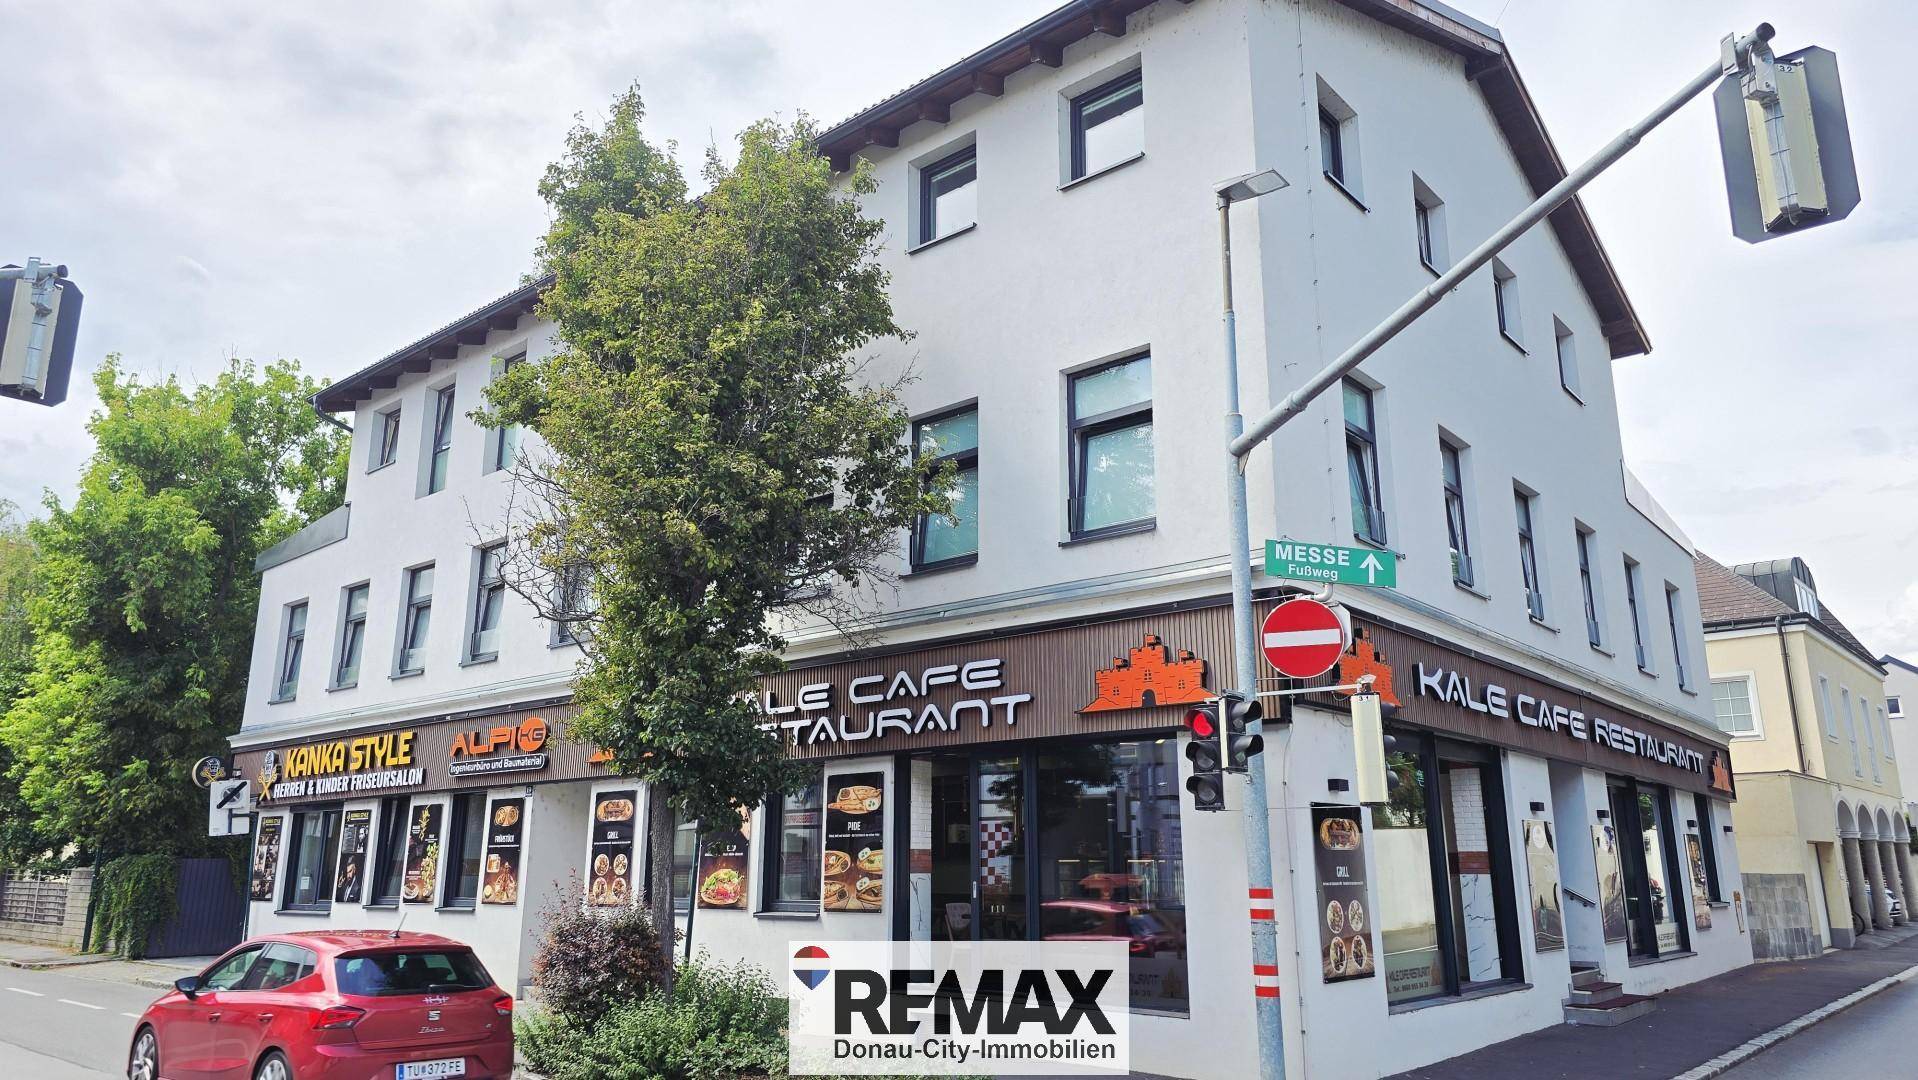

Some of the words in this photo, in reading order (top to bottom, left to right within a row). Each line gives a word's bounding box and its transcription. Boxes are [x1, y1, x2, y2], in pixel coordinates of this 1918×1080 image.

[1275, 543, 1350, 566] MESSE
[1288, 564, 1338, 580] Fußweg
[727, 682, 830, 715] ALE
[849, 658, 1001, 704] CAFE
[753, 693, 1031, 746] TAURANT
[1418, 662, 1509, 718] KALE
[1517, 693, 1587, 740] CAFE
[1594, 717, 1704, 774] RESTAURANT
[284, 741, 345, 779] KANKA
[350, 731, 414, 771] STYLE
[450, 726, 516, 757] ALPI
[491, 760, 503, 769] und
[273, 780, 306, 799] HERREN
[307, 780, 314, 796] &
[316, 775, 350, 795] KINDER
[350, 767, 424, 791] FRISEURSALON
[847, 821, 861, 831] PIDE
[428, 1062, 447, 1075] 372
[449, 1060, 461, 1073] FE
